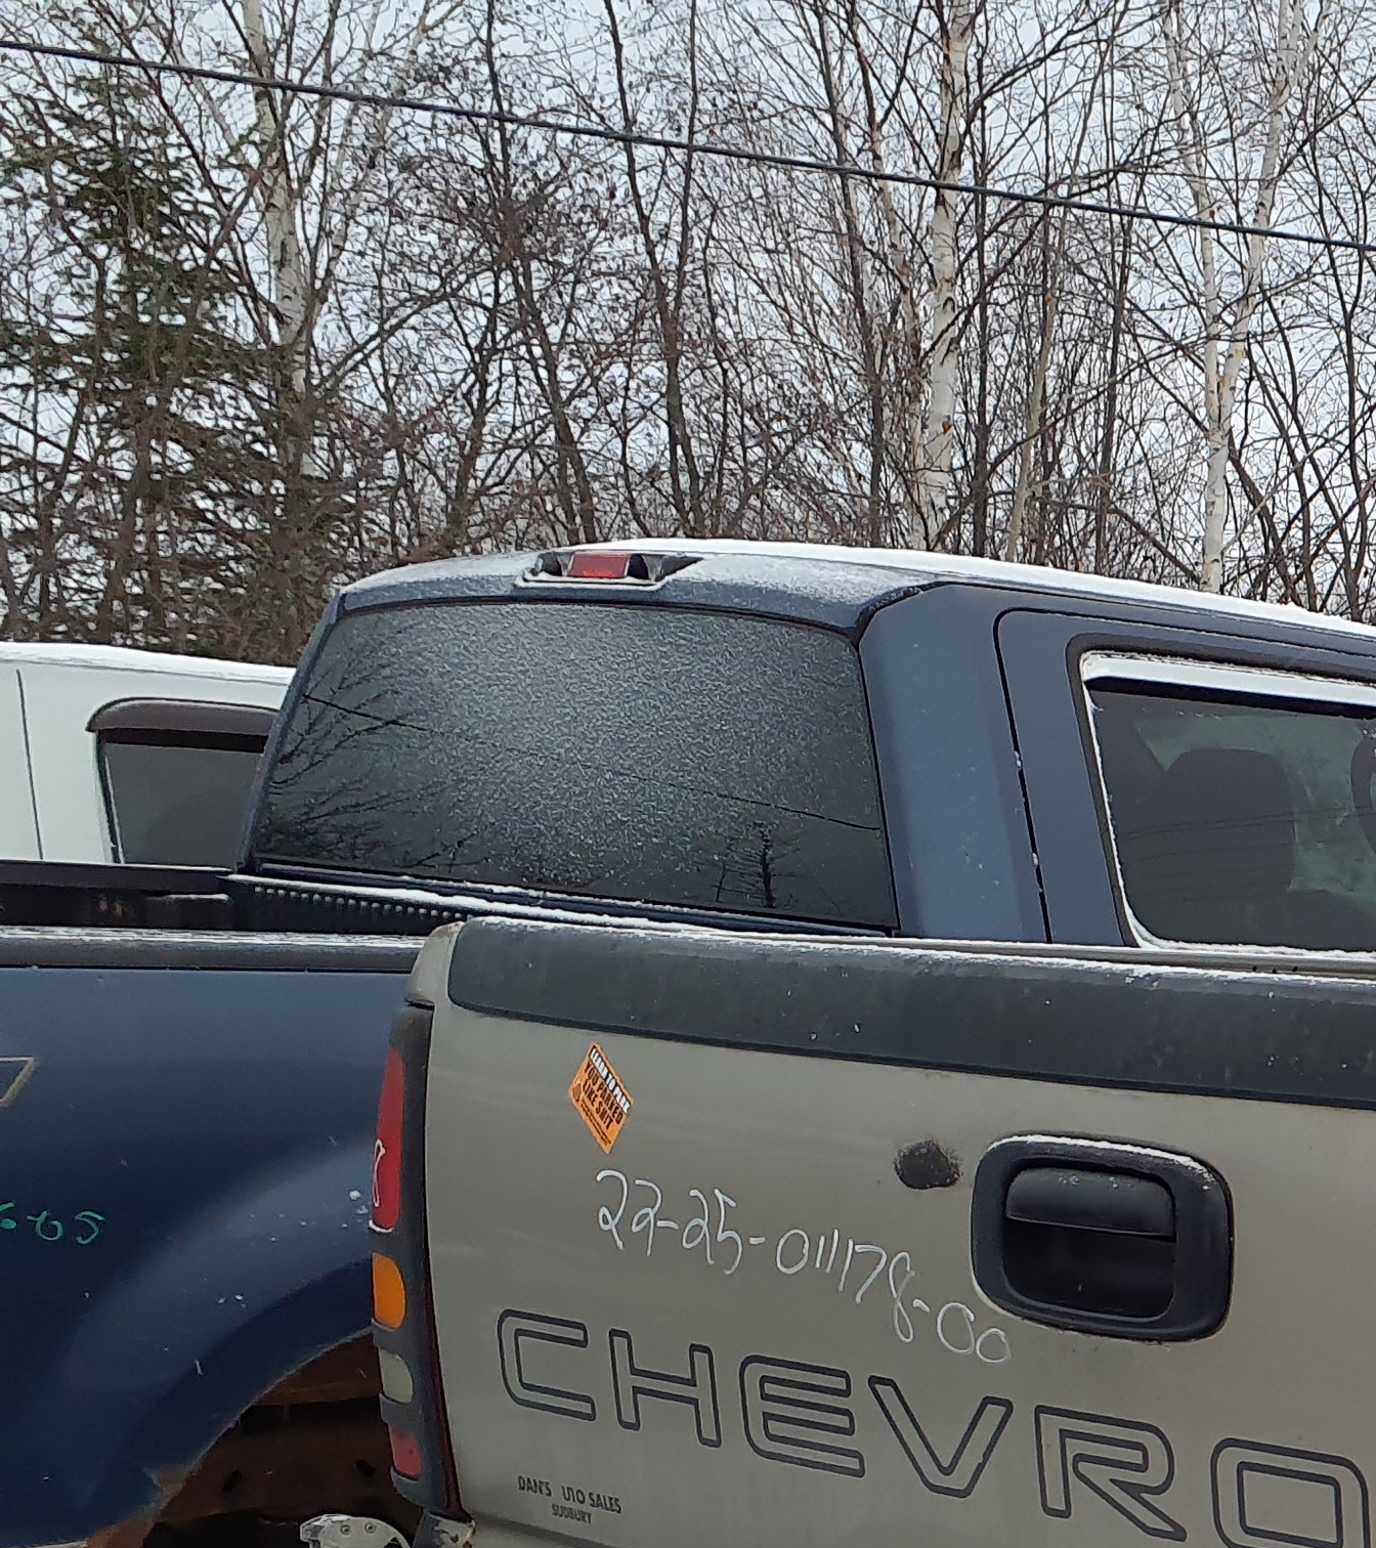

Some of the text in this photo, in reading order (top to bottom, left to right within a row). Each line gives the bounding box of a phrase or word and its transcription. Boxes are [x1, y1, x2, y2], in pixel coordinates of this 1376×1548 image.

[582, 1081, 599, 1107] LIKE
[595, 1100, 614, 1130] SHIT
[583, 1061, 600, 1087] YOU
[596, 1081, 625, 1125] PARKED
[597, 1169, 1012, 1364] 22-25-011178-00
[588, 1491, 622, 1514] SALES
